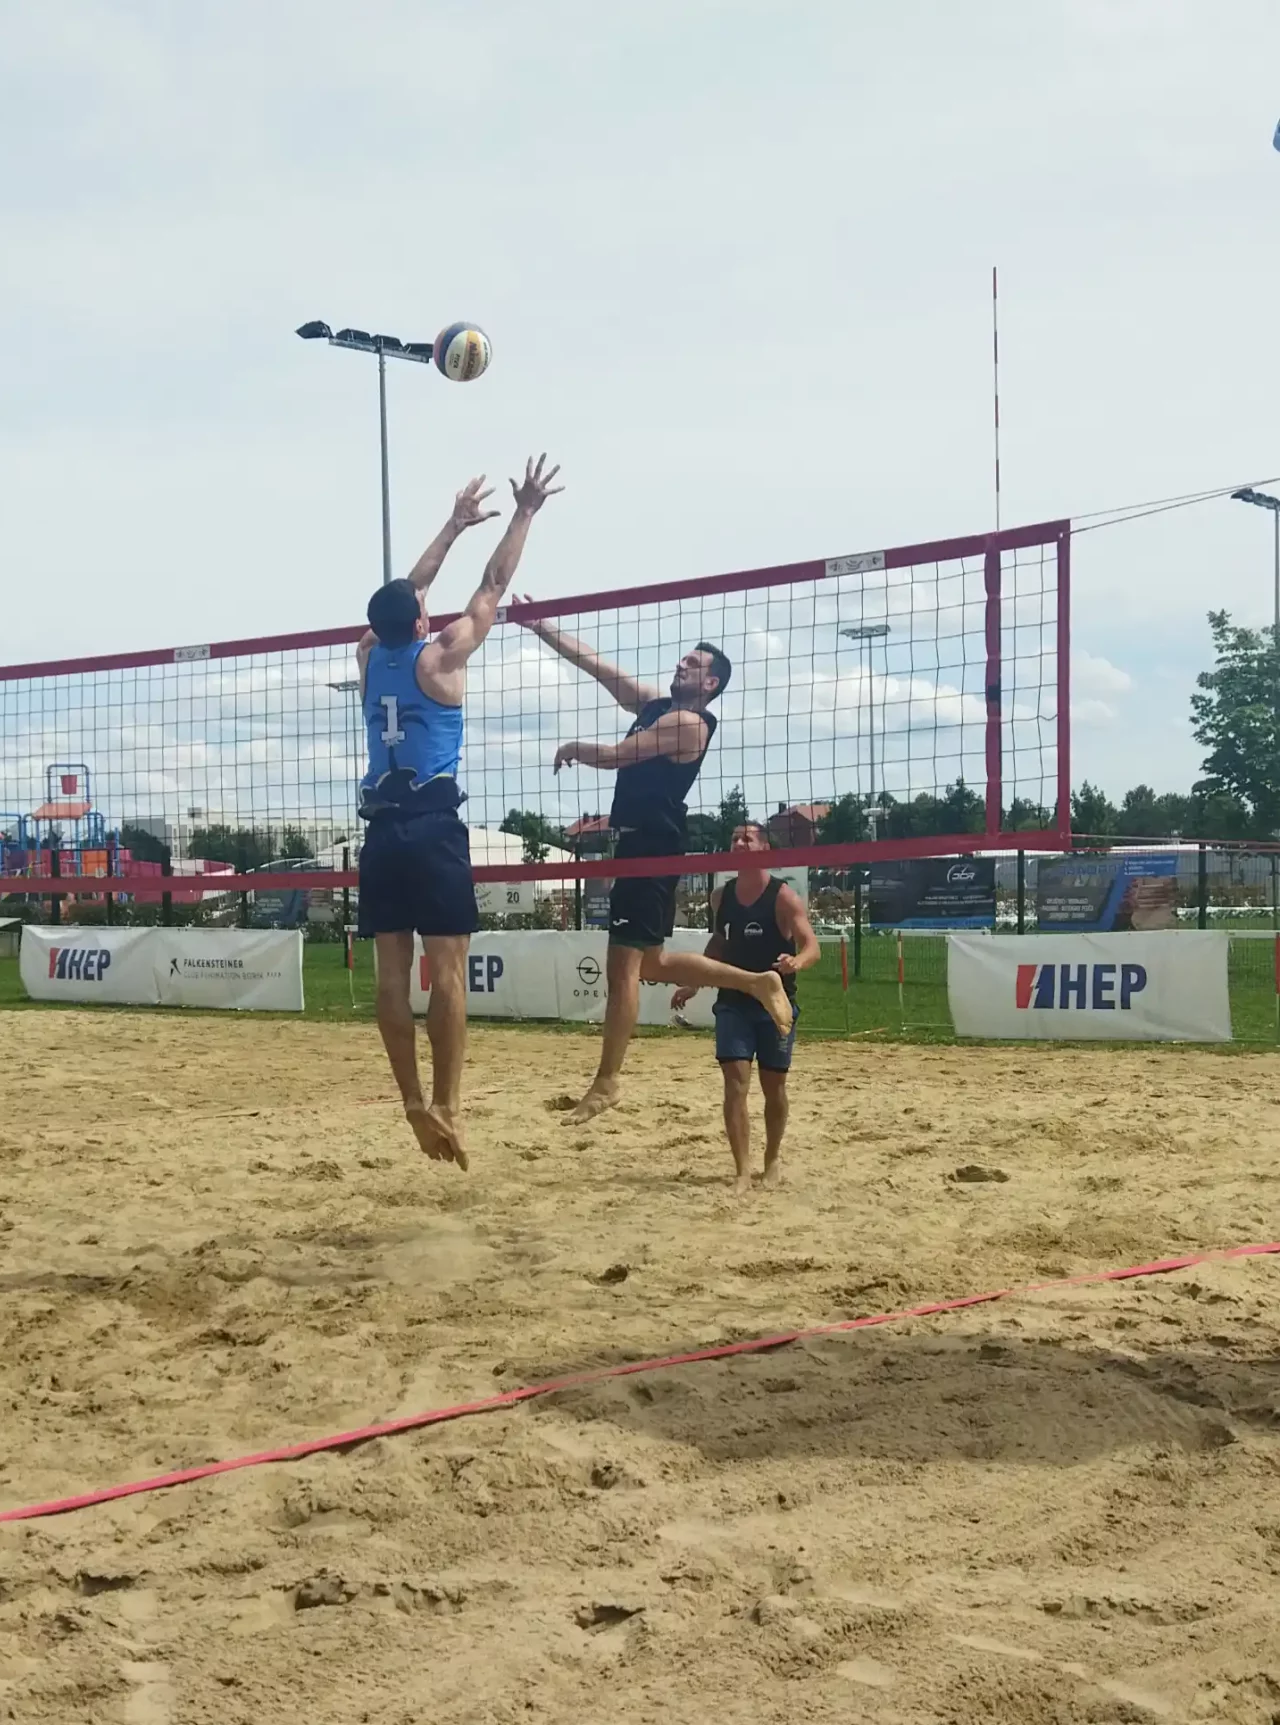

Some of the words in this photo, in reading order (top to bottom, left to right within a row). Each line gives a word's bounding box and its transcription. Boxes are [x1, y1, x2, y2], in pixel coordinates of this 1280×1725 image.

[381, 696, 405, 740] 1
[506, 891, 520, 904] 20
[724, 922, 731, 940] 1
[68, 949, 111, 980] HEP
[183, 958, 244, 968] FALKENSTEINER
[469, 954, 505, 992] EP
[1059, 964, 1148, 1010] HEP
